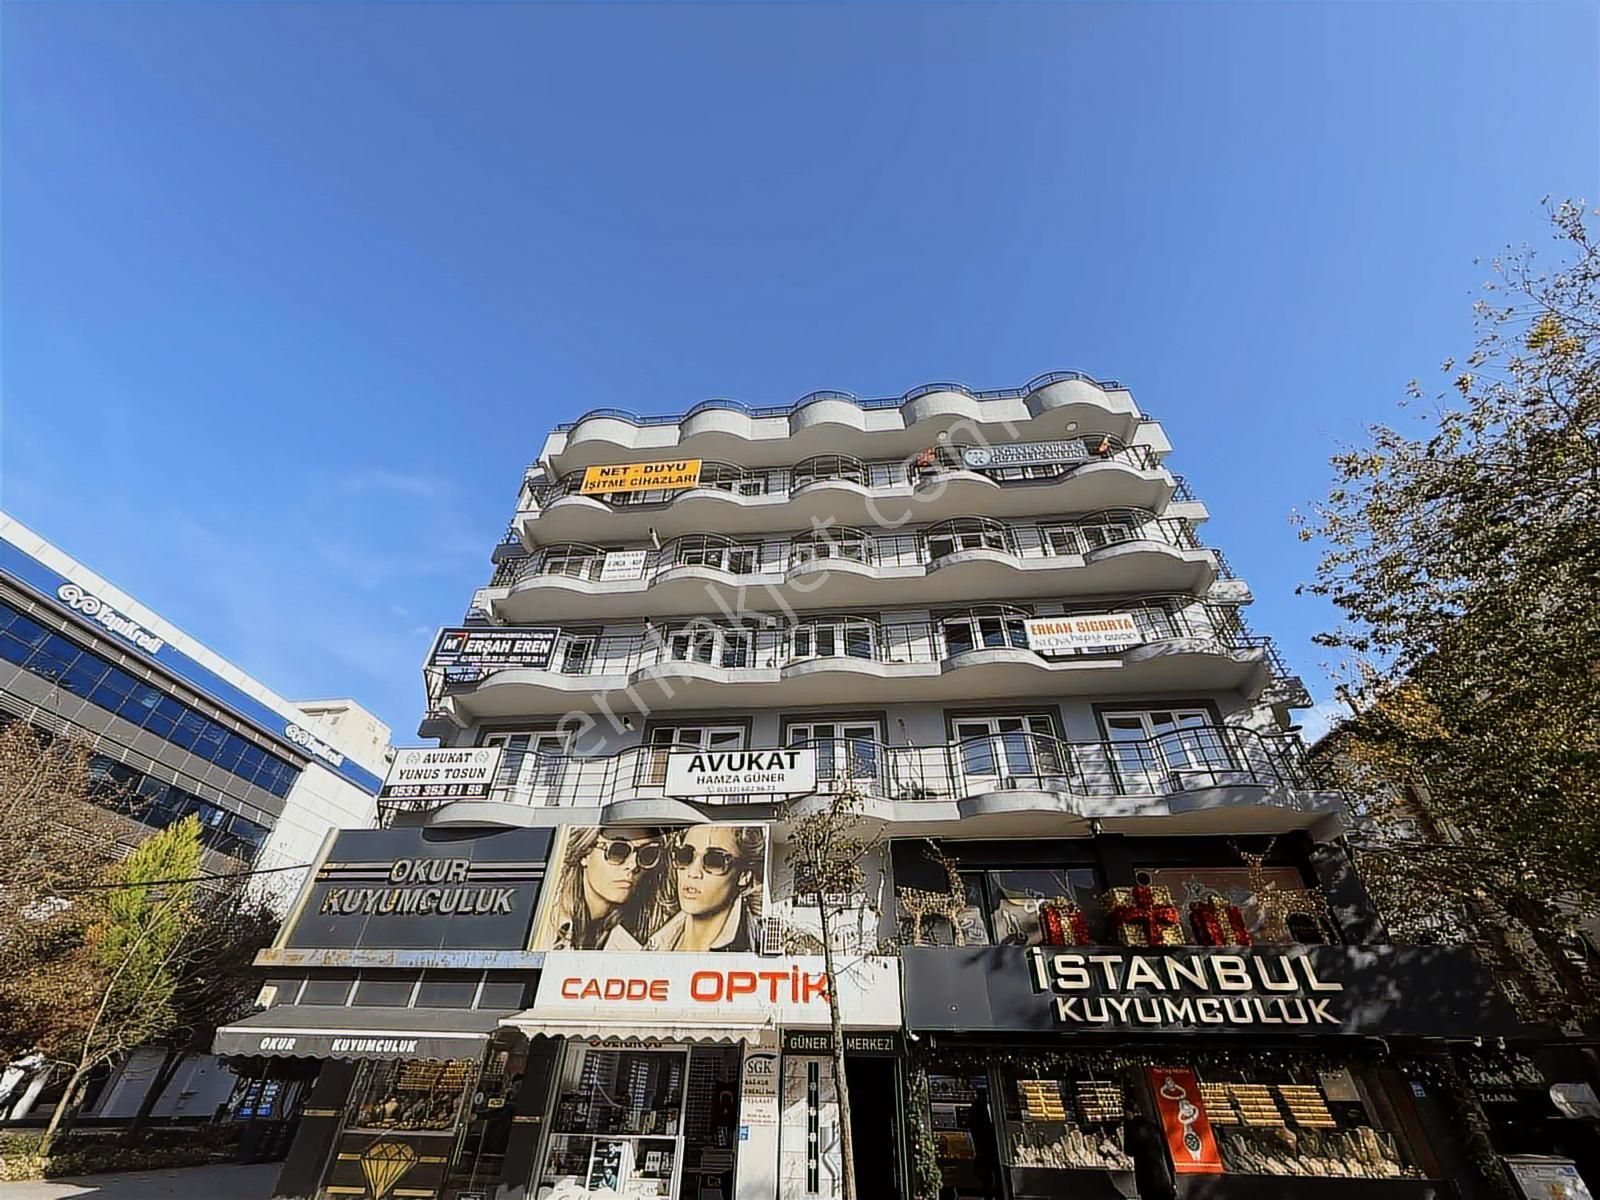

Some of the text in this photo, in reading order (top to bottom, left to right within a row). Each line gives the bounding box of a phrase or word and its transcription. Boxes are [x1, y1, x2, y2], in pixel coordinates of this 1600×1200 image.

[600, 466, 630, 476] NET
[644, 463, 686, 473] DUYU
[1031, 619, 1133, 635] ERKAN SİGORTA
[464, 640, 551, 656] ERŞAH EREN
[423, 752, 472, 764] AVUKAT
[687, 751, 800, 772] AVUKAT
[399, 767, 486, 780] YUNUS TOSUN
[697, 771, 785, 784] HAMZA GÜNER
[390, 858, 470, 883] OKUR
[321, 888, 515, 914] KUYUMCULUK
[1032, 946, 1344, 991] İSTANBUL
[561, 978, 670, 1001] CADDE
[690, 965, 831, 1004] OPTİK
[1056, 997, 1344, 1025] KUYUMCULUK
[260, 1037, 417, 1053] OKUR KUYUMCULUK
[790, 1034, 827, 1049] GÜNER
[846, 1035, 894, 1050] MERKEZİ
[747, 1060, 772, 1074] SGK
